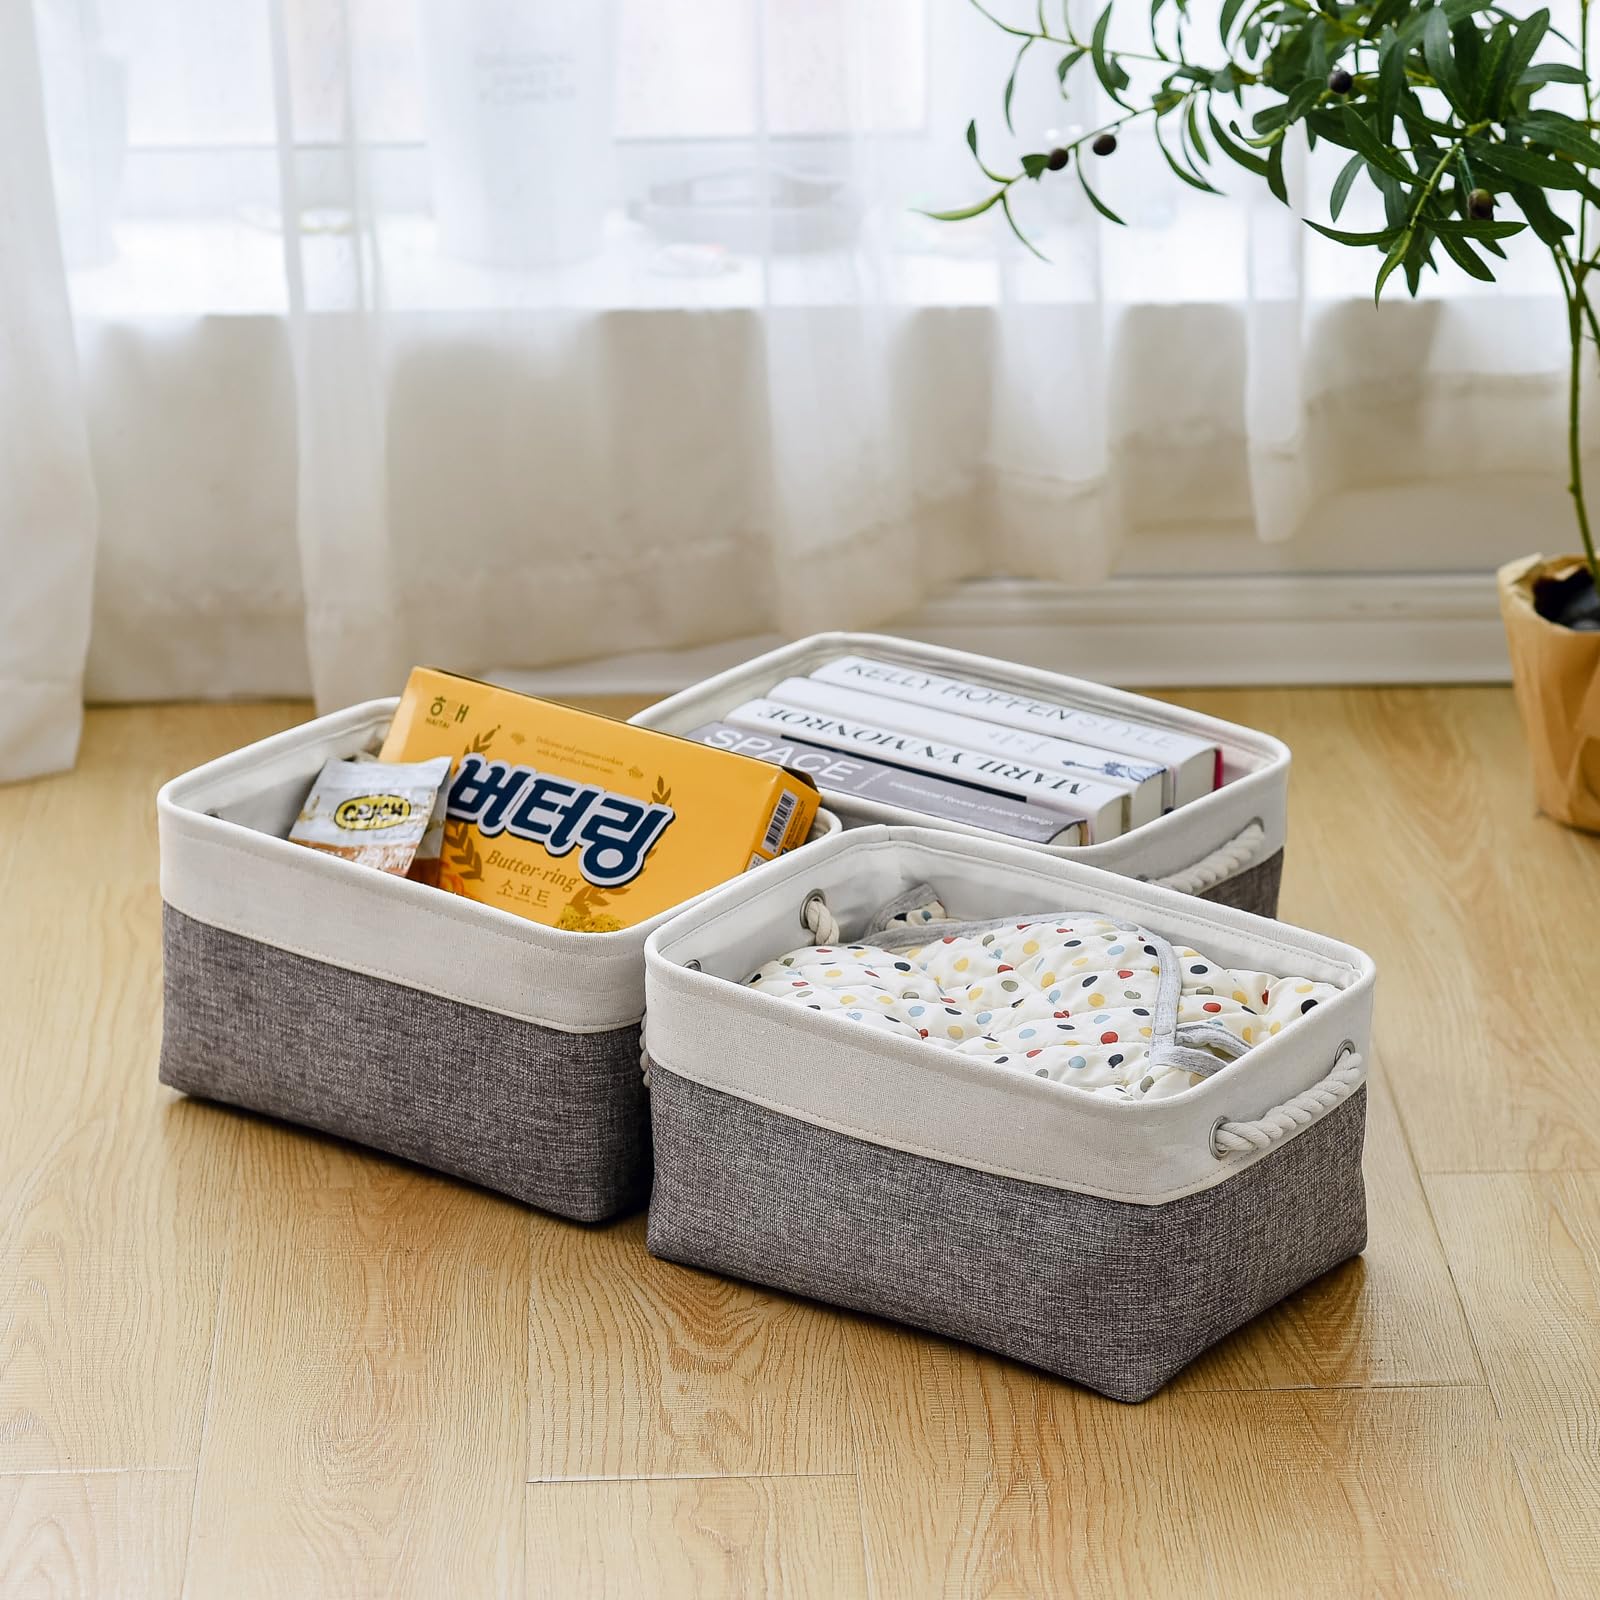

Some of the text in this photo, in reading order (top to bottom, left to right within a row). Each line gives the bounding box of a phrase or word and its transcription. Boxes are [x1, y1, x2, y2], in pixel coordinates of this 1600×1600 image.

[756, 707, 919, 752] MONROE
[845, 662, 931, 689] KELLY
[941, 684, 1075, 721] HOPPEN
[1078, 715, 1181, 750] STYLE
[703, 728, 865, 782] SPACE
[917, 742, 1092, 795] MARILYN
[446, 754, 674, 886] 버터링
[485, 849, 580, 893] Butter-ring
[496, 879, 550, 908] 소프트
